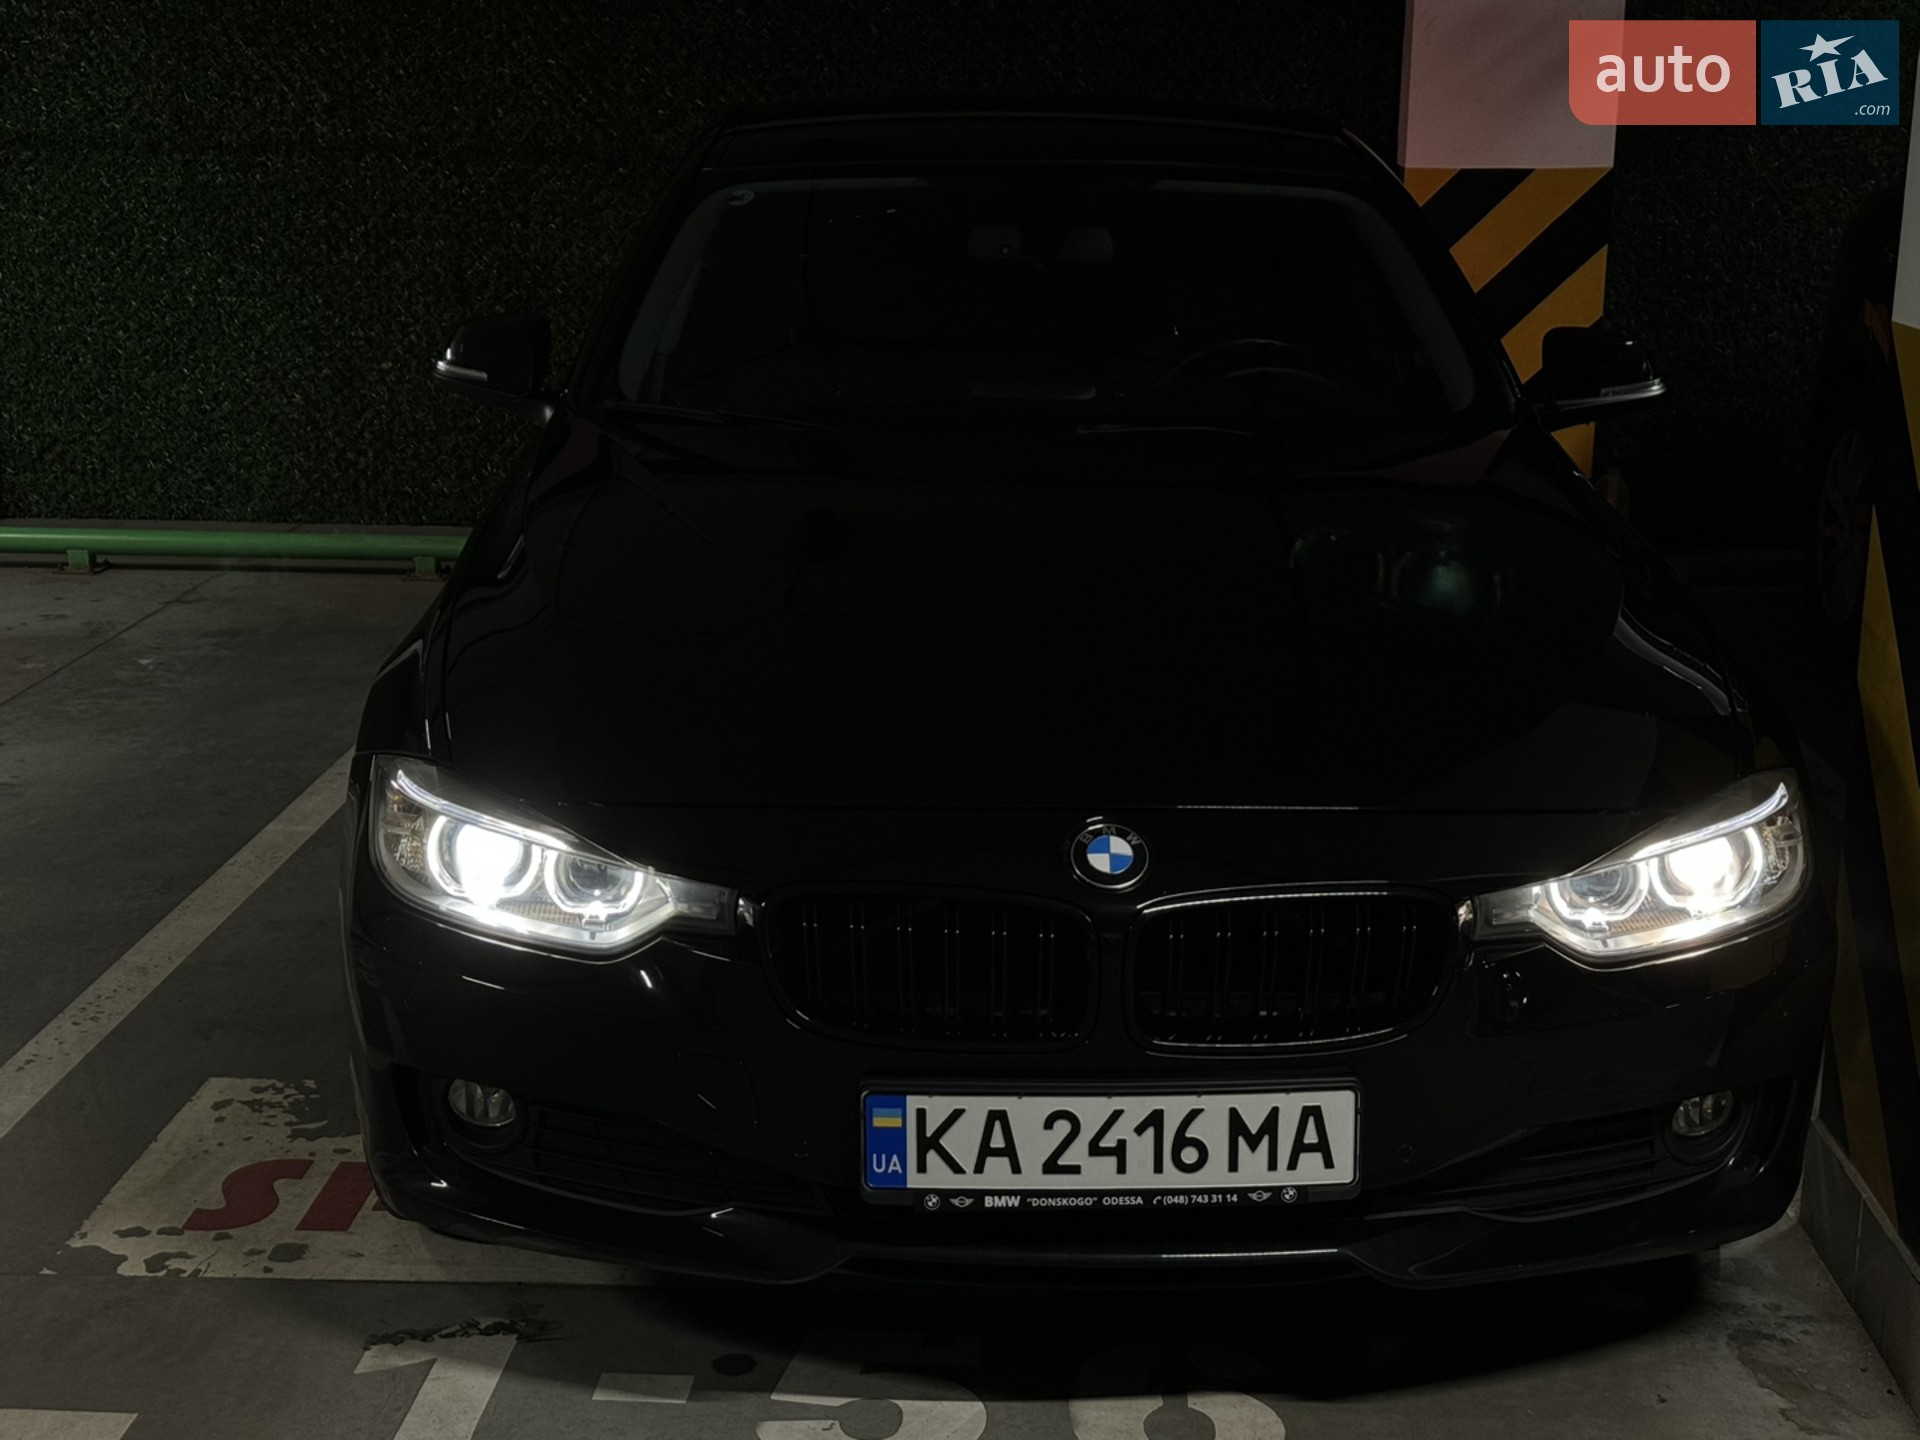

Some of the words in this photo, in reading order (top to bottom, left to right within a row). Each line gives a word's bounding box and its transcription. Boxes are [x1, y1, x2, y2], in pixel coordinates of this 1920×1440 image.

[1080, 826, 1141, 846] BMW
[916, 1107, 1023, 1174] KA
[1042, 1107, 1209, 1174] 2416
[1228, 1104, 1335, 1172] MA
[872, 1152, 903, 1174] UA
[984, 1195, 1022, 1208] BMW
[1102, 1195, 1144, 1206] ODESSA
[1163, 1194, 1188, 1206] (048)
[1191, 1193, 1209, 1204] 743
[1210, 1193, 1223, 1203] 31
[1225, 1192, 1238, 1203] 14
